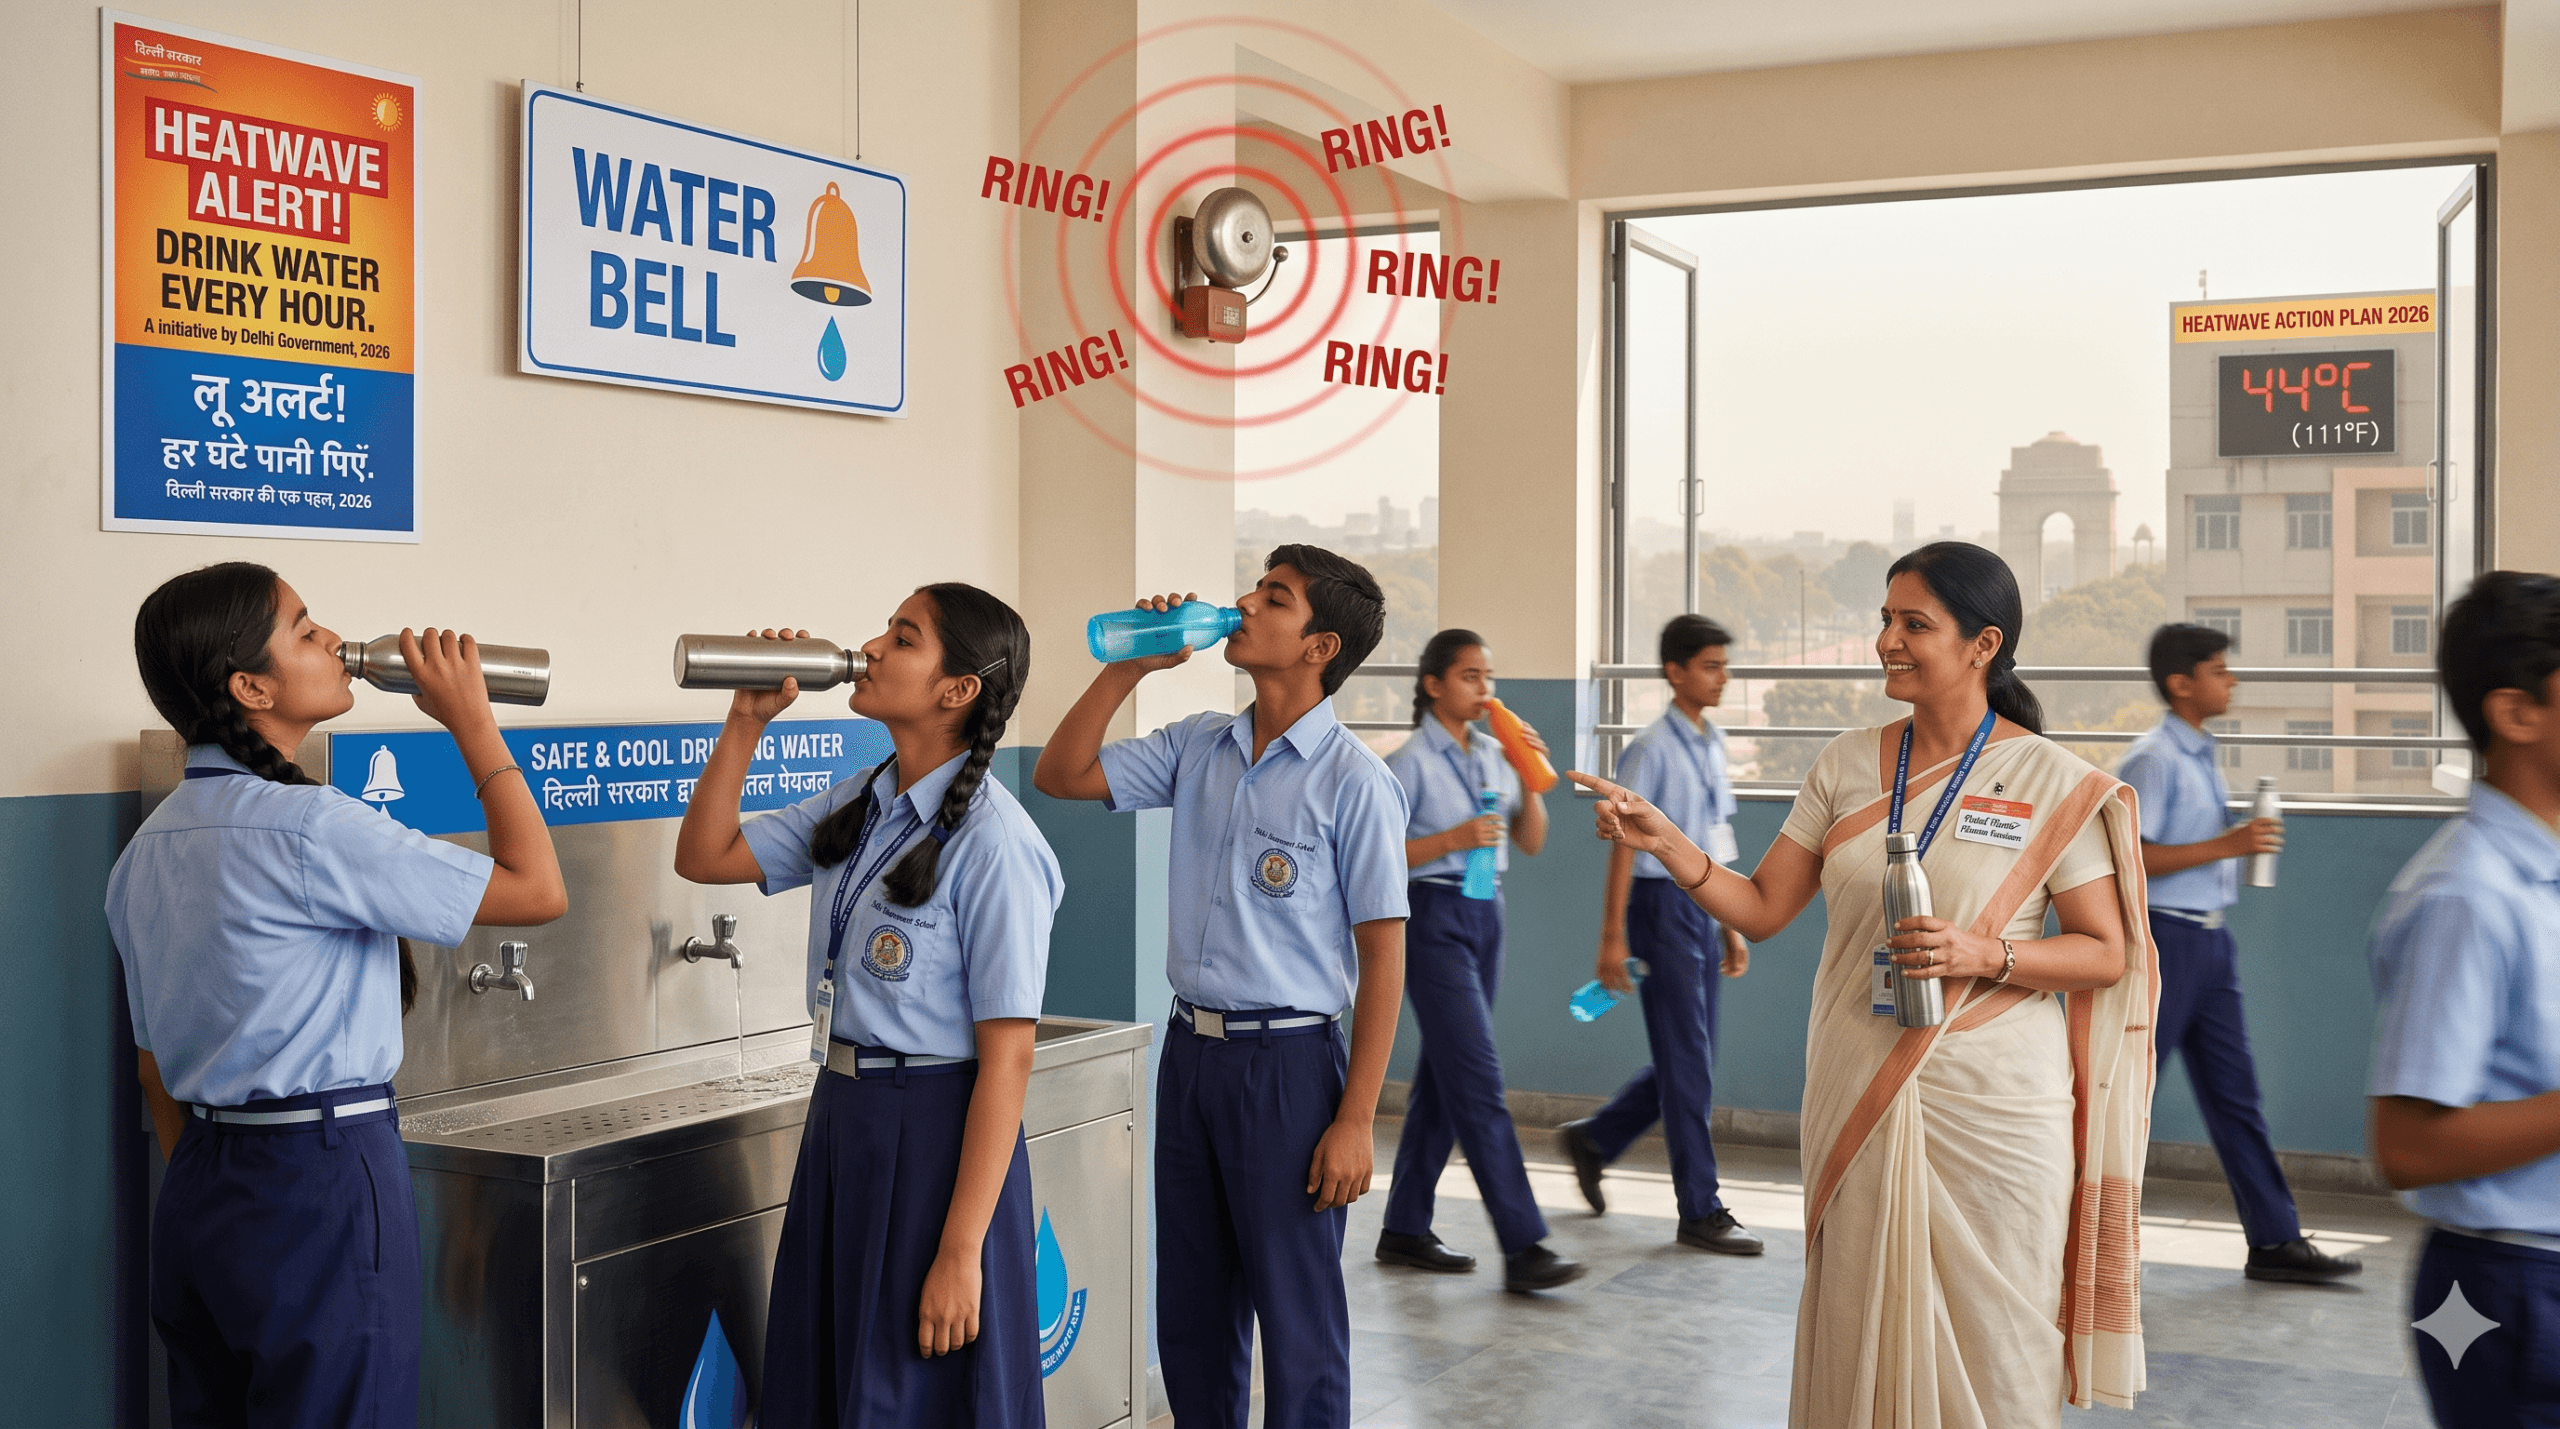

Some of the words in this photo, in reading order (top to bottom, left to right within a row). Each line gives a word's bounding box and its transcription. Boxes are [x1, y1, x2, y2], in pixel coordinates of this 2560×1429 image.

[154, 107, 381, 190] HEATWAVE
[195, 171, 342, 236] ALERT!
[571, 146, 777, 263] WATER
[156, 228, 263, 277] DRINK
[271, 244, 380, 293] WATER
[161, 272, 269, 320] EVERY
[280, 288, 375, 333] HOUR.
[590, 249, 736, 348] BELL
[2182, 312, 2270, 333] HEATWAVE
[2274, 309, 2334, 329] ACTION
[2339, 307, 2383, 326] PLAN
[2388, 304, 2430, 324] 2026
[144, 318, 155, 333] A
[158, 319, 218, 340] initiative
[221, 326, 237, 345] by
[241, 328, 274, 346] Delhi
[278, 333, 357, 358] Government,
[360, 342, 390, 360] 2026
[191, 373, 236, 428] लू
[240, 373, 345, 423] अलर्ट!
[160, 437, 199, 469] हर
[205, 432, 249, 469] घंटे
[254, 437, 315, 475] पानी
[165, 478, 206, 499] दिल्ली
[209, 486, 255, 502] सरकार
[257, 484, 276, 503] की
[277, 490, 301, 506] एक
[303, 491, 336, 510] पहल,
[339, 493, 372, 509] 2026
[531, 742, 588, 771] SAFE
[594, 741, 611, 768] &
[617, 739, 674, 767] COOL
[780, 733, 844, 759] WATER
[542, 774, 601, 810] दिल्ली
[777, 763, 833, 794] पेयजल
